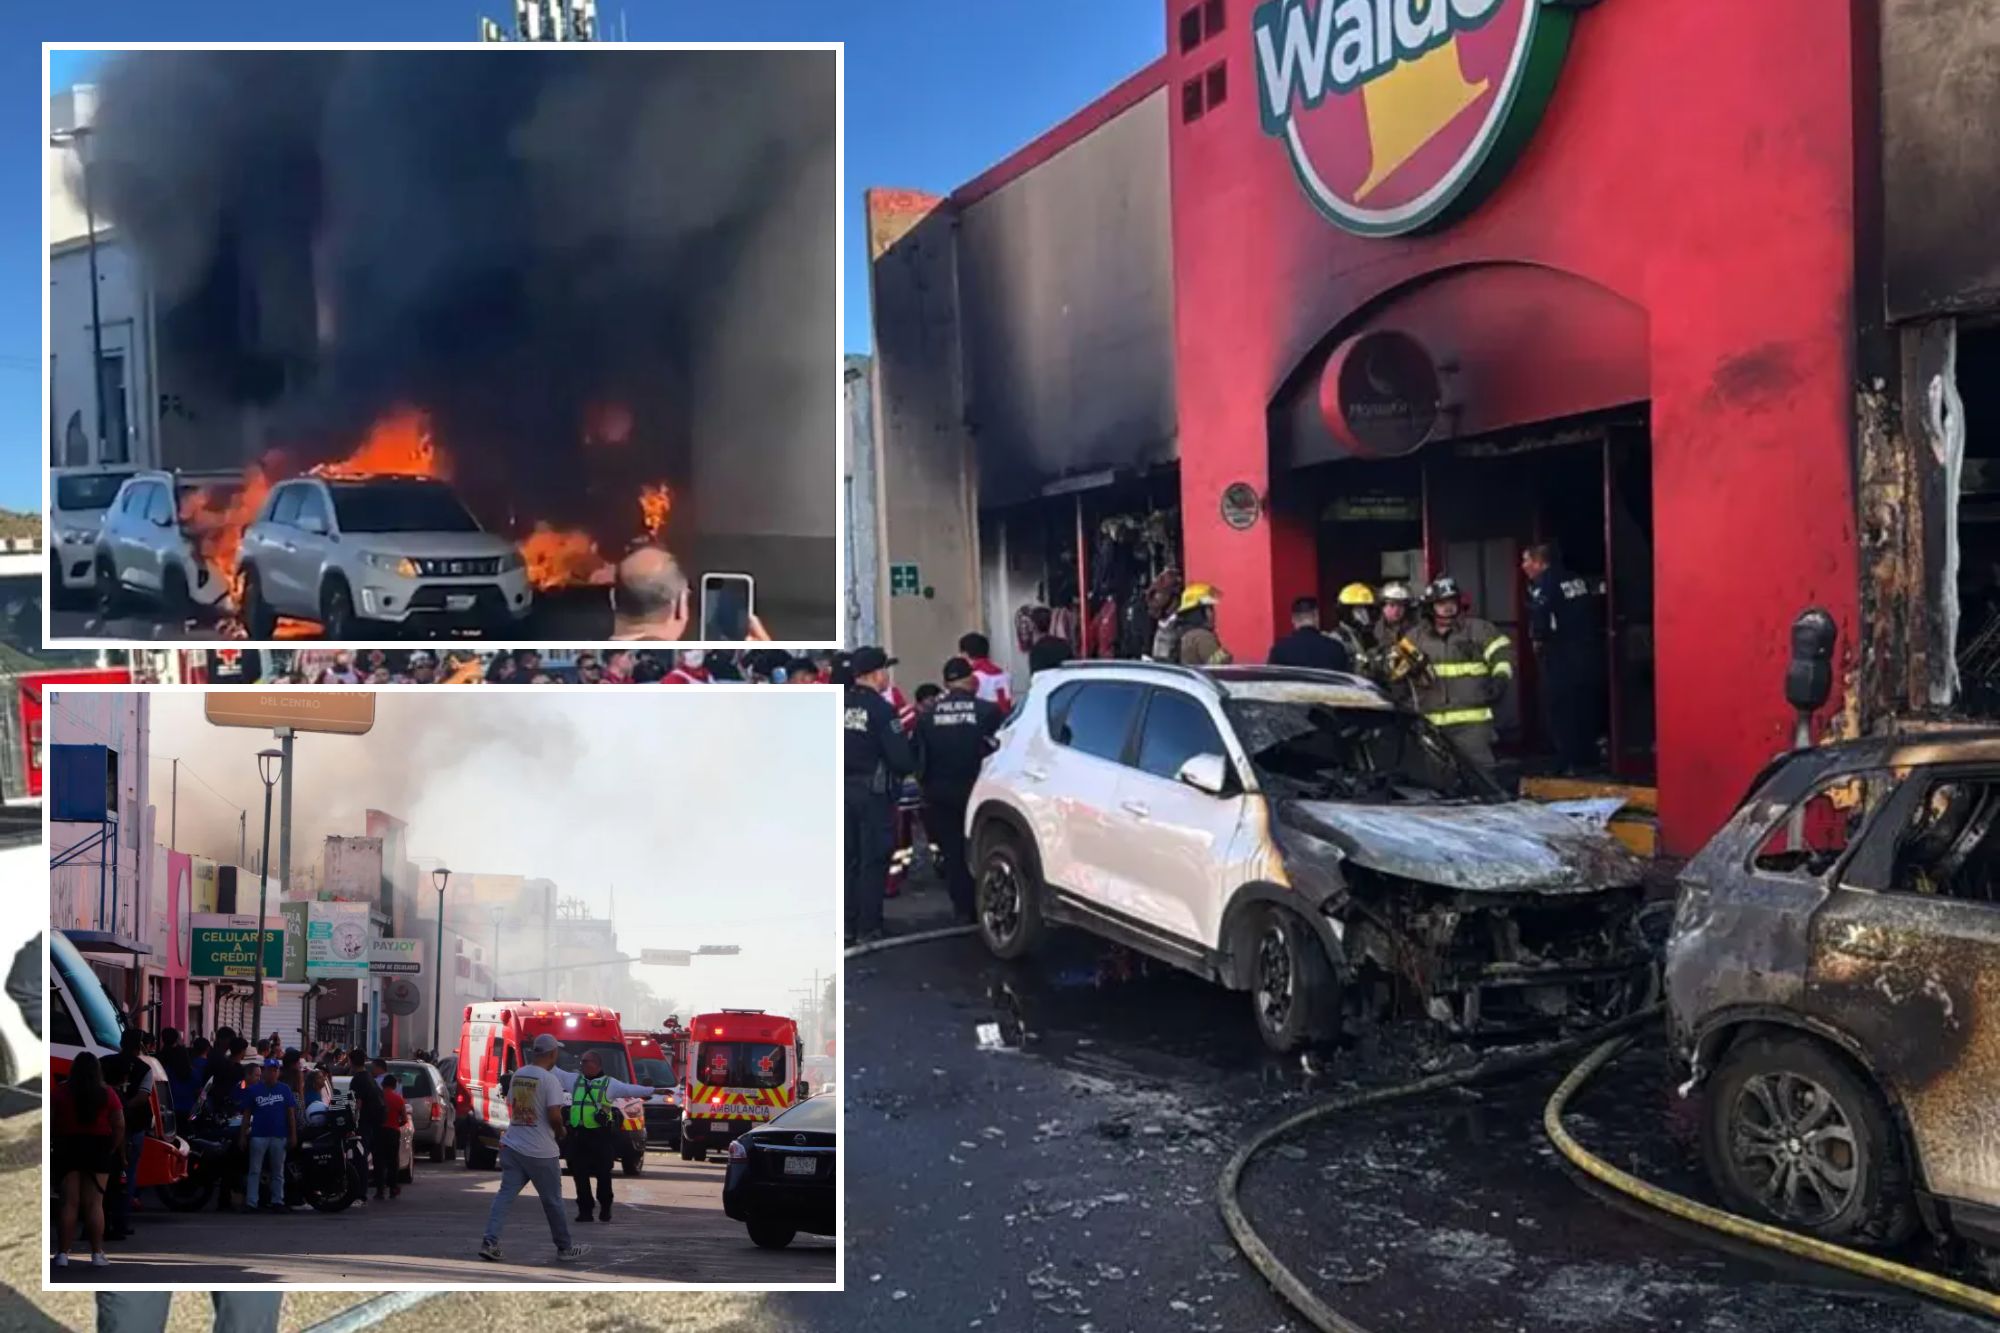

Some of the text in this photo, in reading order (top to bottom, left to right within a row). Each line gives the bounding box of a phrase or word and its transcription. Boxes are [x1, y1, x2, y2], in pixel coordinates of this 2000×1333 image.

[1256, 0, 1491, 117] Wald
[260, 696, 320, 709] DEL CENTRO
[233, 942, 242, 952] A
[373, 941, 416, 951] PAYJOY
[211, 952, 257, 962] CREDIT
[256, 1094, 284, 1106] Dodgers
[710, 1104, 770, 1117] AMBULANCIA
